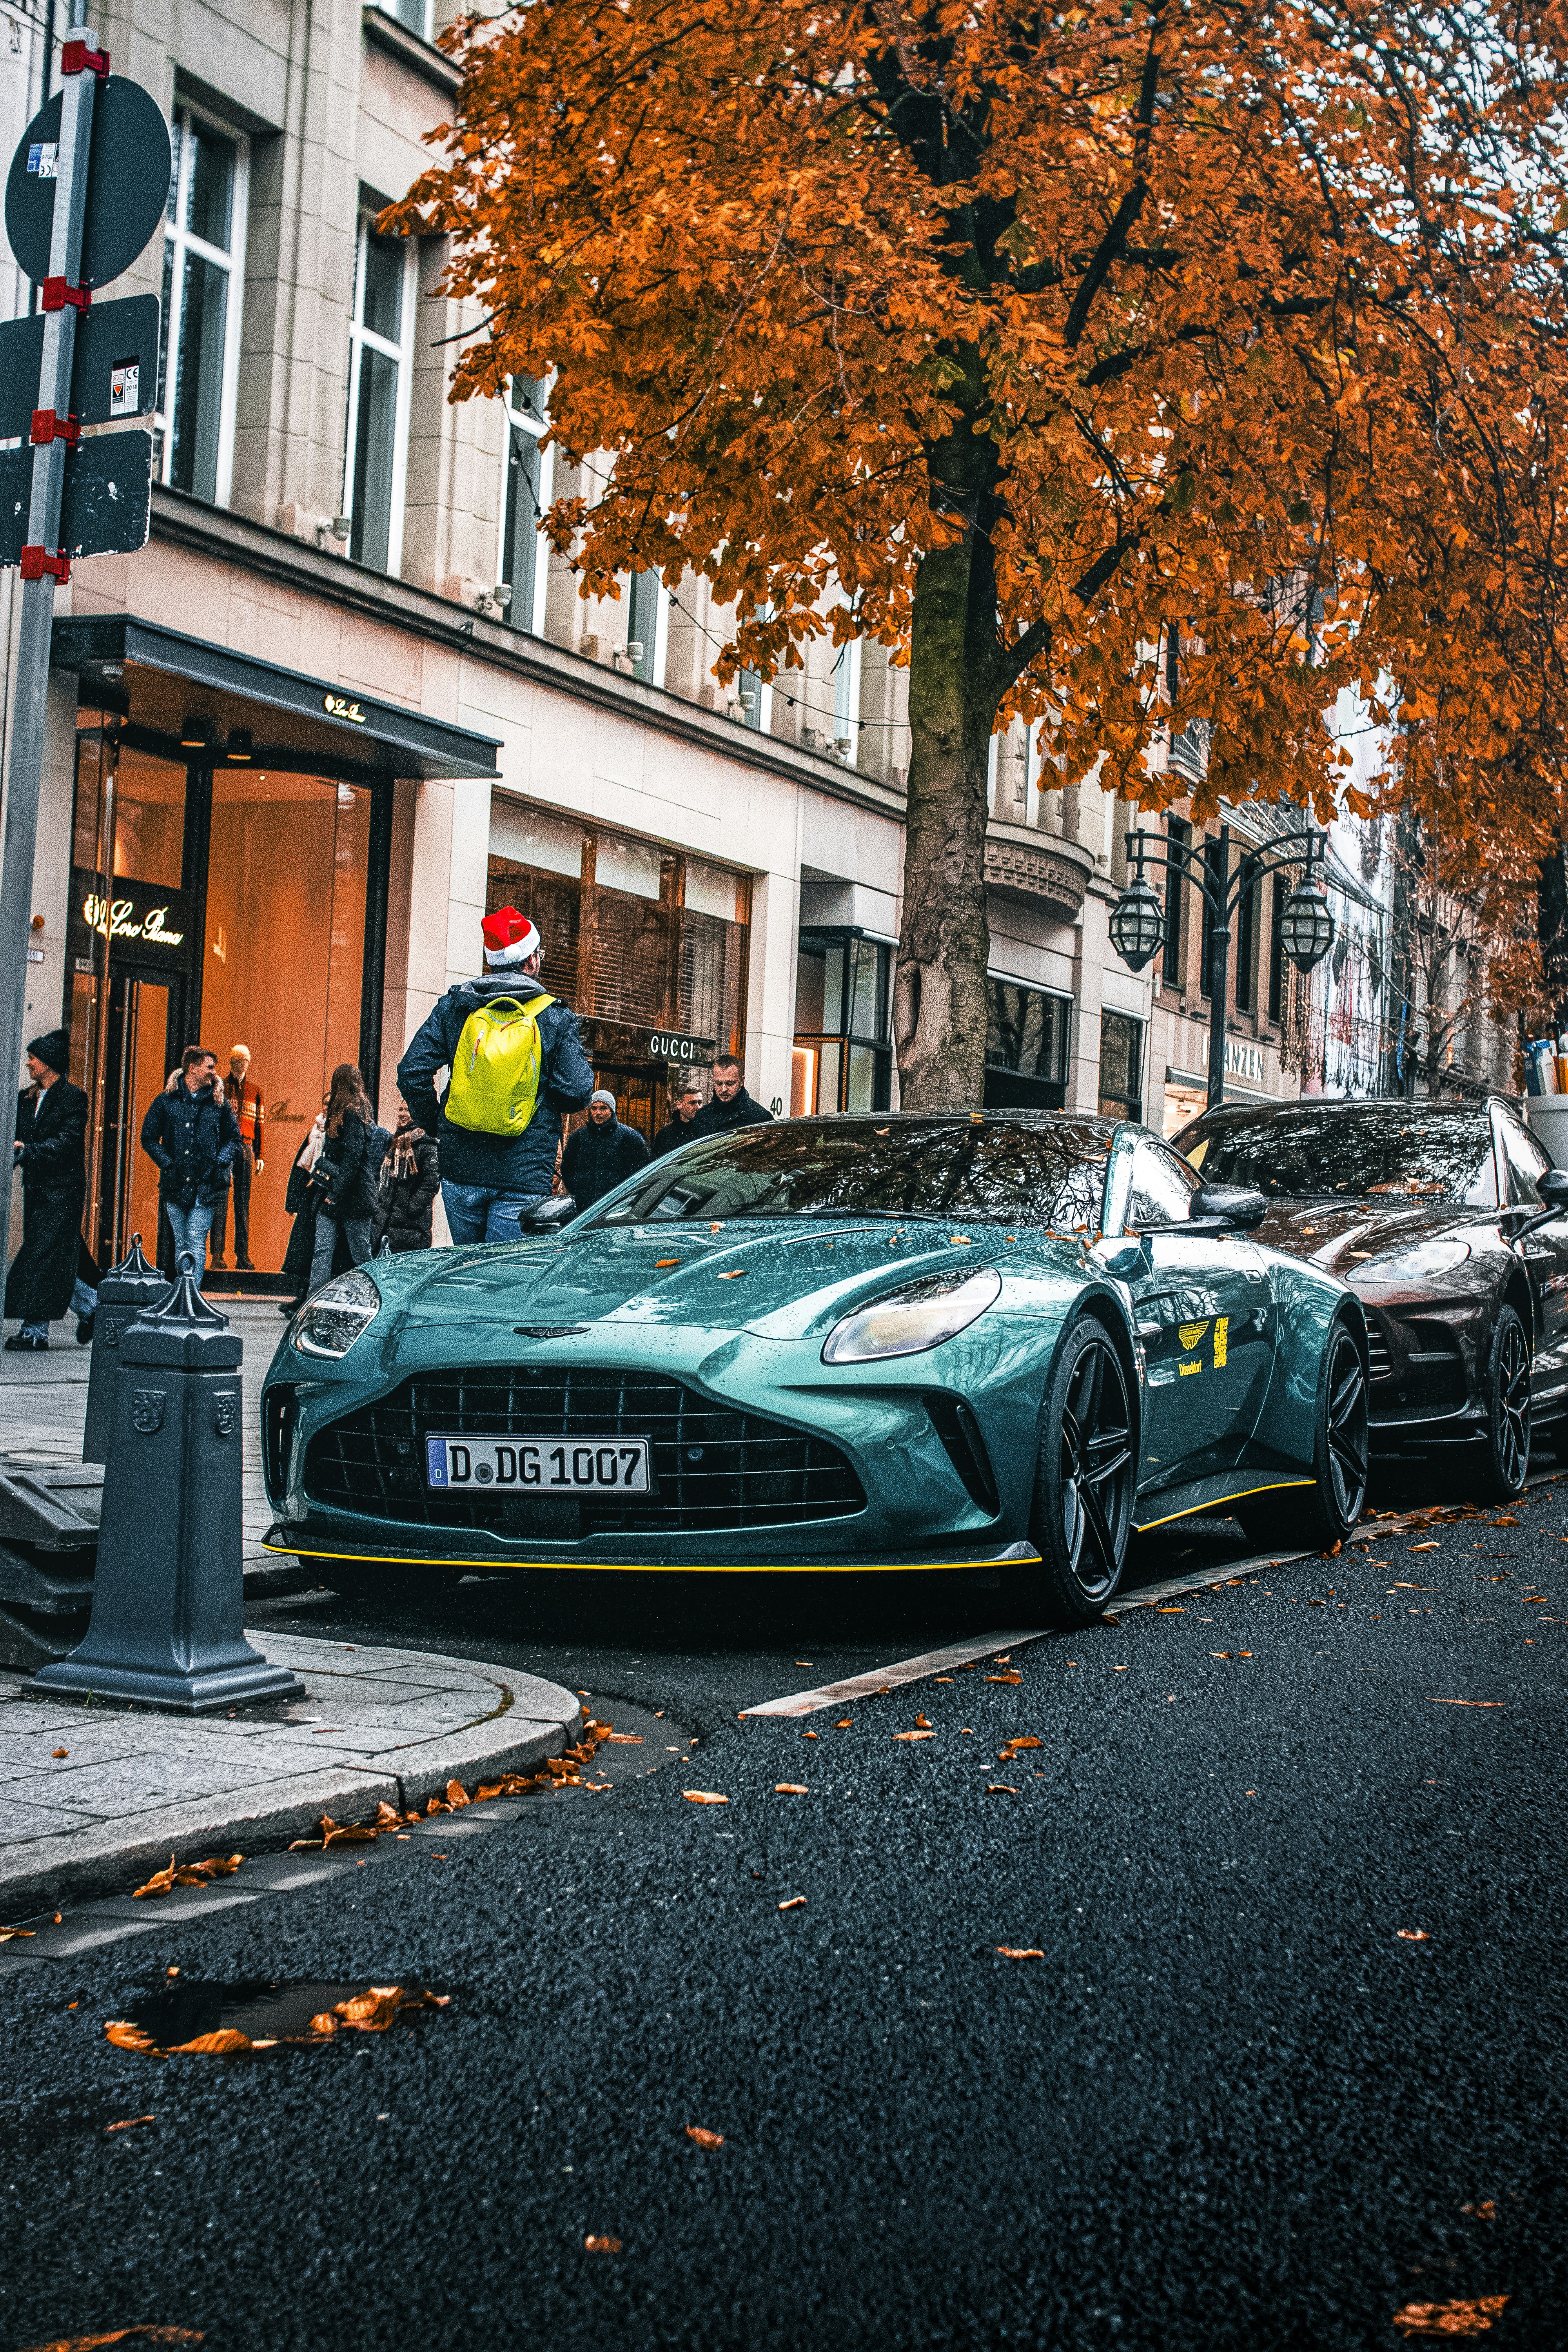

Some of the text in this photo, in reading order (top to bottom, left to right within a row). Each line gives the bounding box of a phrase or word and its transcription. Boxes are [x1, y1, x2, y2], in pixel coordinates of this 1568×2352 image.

[127, 367, 138, 379] CE
[111, 900, 143, 937] Loro
[142, 906, 183, 945] Piana
[651, 1036, 693, 1059] GUCCI
[770, 1096, 782, 1116] 40
[1178, 1359, 1202, 1376] Düsseldorf
[435, 1469, 442, 1479] D
[449, 1445, 641, 1485] D DG 1007
